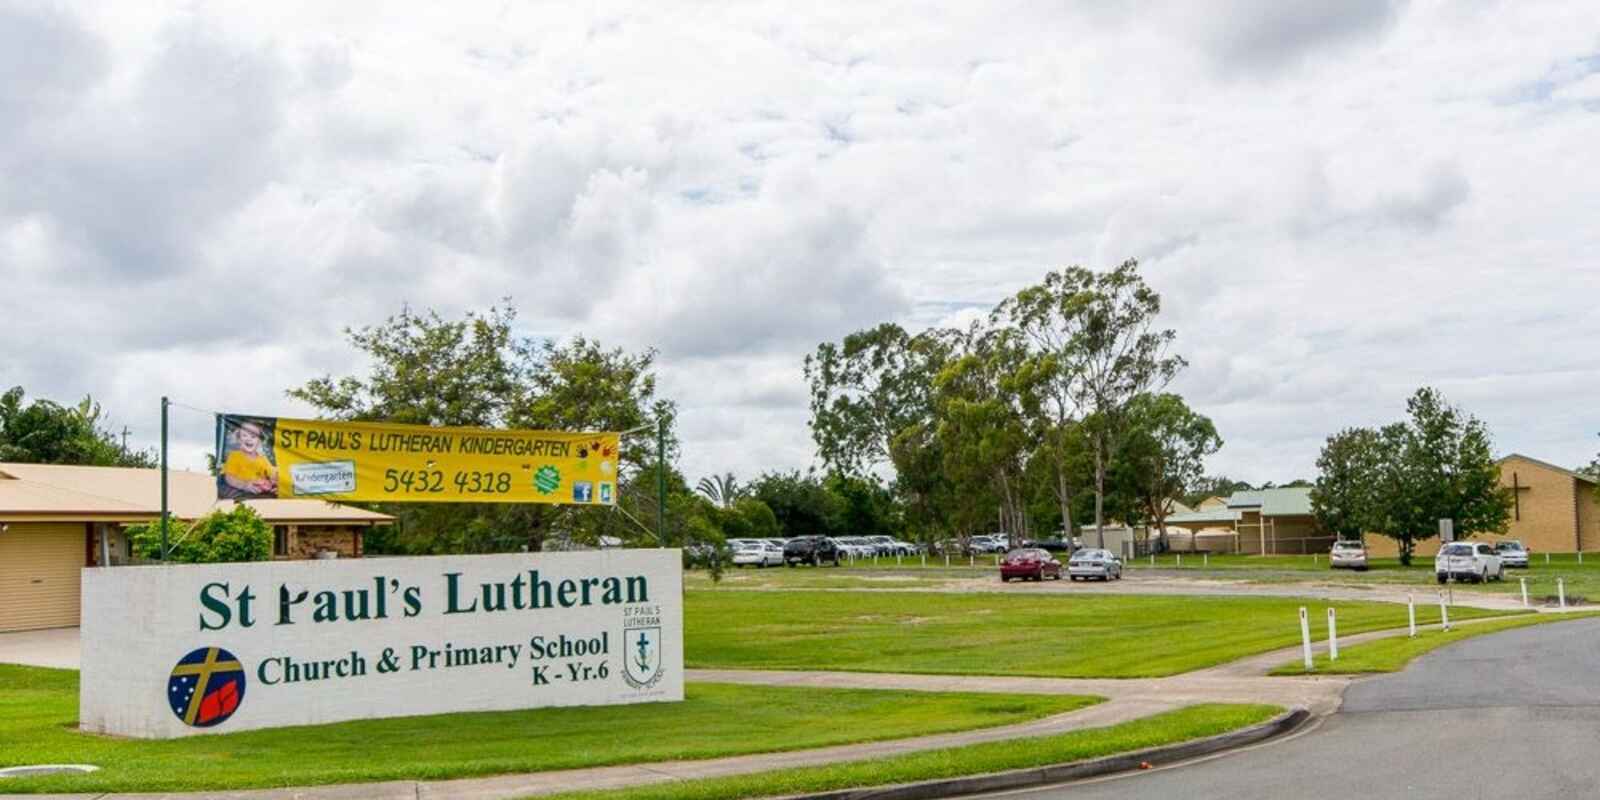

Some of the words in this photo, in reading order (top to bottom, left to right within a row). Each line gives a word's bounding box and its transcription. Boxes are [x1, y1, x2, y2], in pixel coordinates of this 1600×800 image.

[281, 430, 304, 449] ST
[306, 431, 361, 450] PAUL'S
[369, 432, 453, 452] LUTHERAN
[460, 436, 570, 456] KINDERGARTEN
[384, 468, 444, 493] 5432
[454, 471, 511, 493] 4318
[199, 581, 257, 631] St
[274, 576, 422, 626] Paul's
[442, 570, 649, 615] Lutheran
[635, 605, 660, 615] PAULS
[624, 616, 660, 628] LUTHERAN
[257, 651, 367, 685] Church
[376, 647, 400, 674] &
[410, 643, 522, 670] Primary
[530, 631, 609, 660] School
[532, 666, 550, 685] K
[567, 660, 609, 682] Yr.6
